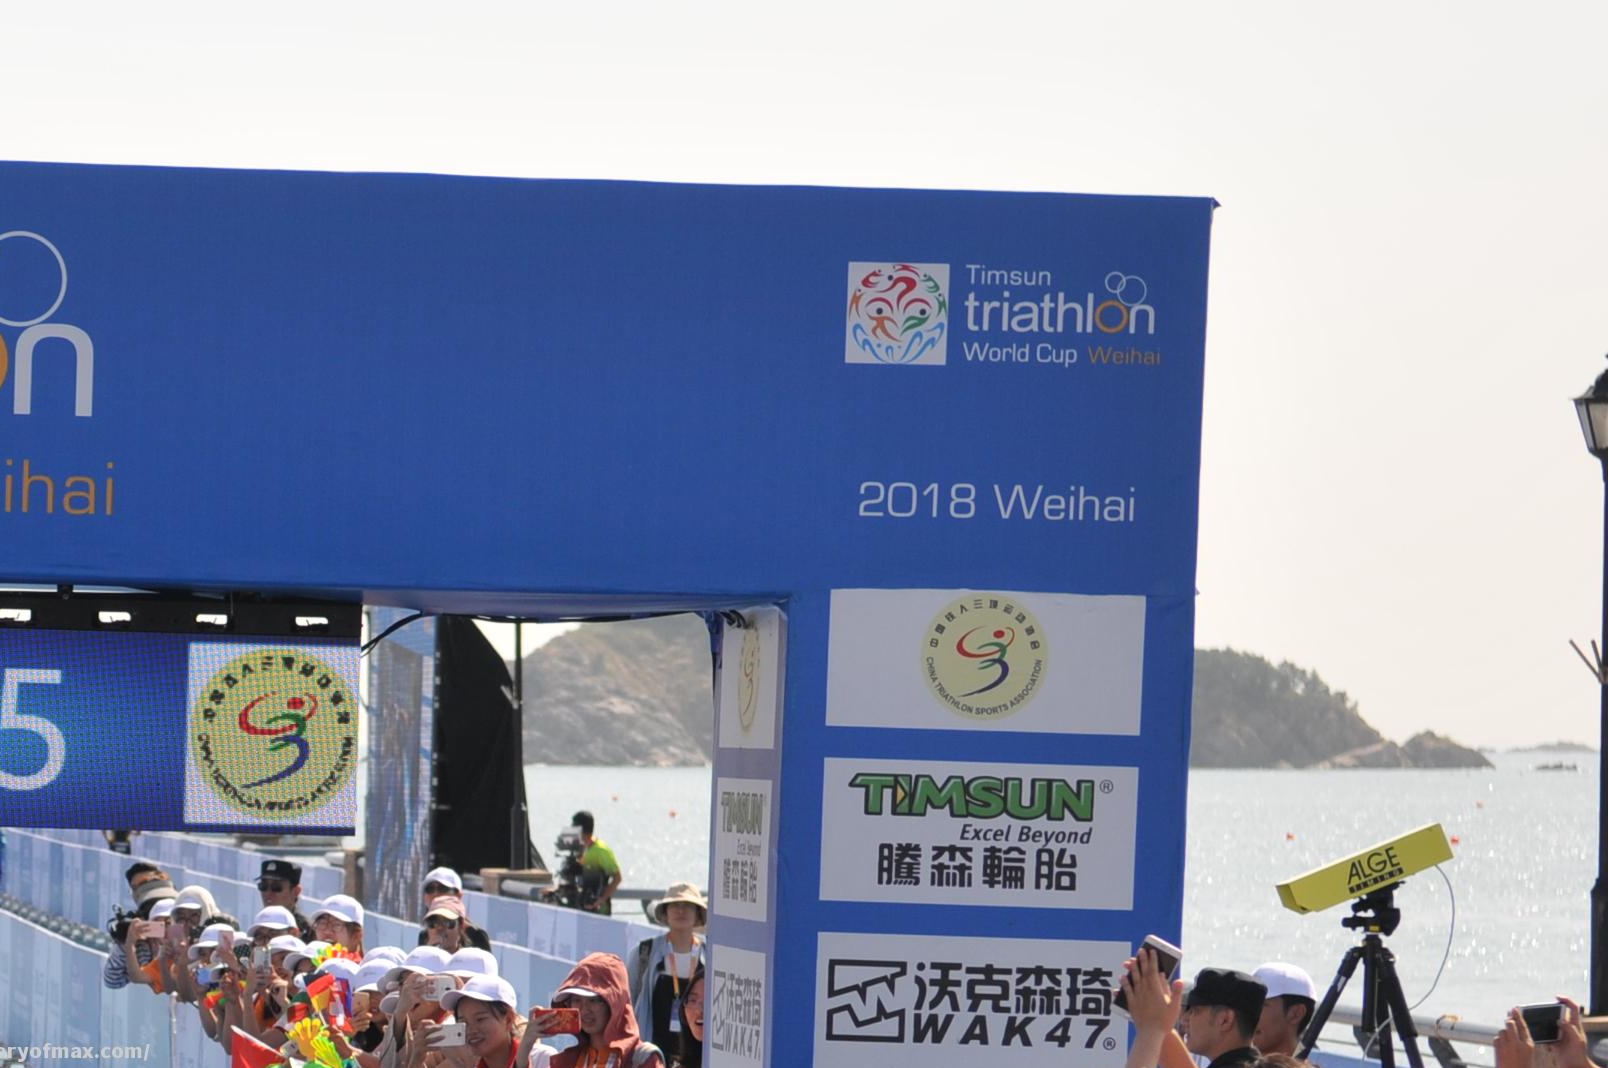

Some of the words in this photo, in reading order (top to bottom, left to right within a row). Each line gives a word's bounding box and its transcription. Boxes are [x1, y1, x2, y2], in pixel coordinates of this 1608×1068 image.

[966, 265, 1051, 286] Timsun
[964, 291, 1155, 334] triathlon
[963, 342, 1029, 363] World
[1036, 344, 1078, 368] Cup
[1087, 346, 1160, 365] Weihai
[859, 481, 976, 518] 2018
[994, 484, 1135, 522] Weihai
[975, 703, 1009, 715] SPORTS
[1009, 659, 1042, 708] ASSOCIATION
[848, 773, 1094, 822] TIMSUN
[960, 824, 1011, 843] Excel
[1018, 827, 1092, 848] Beyond
[877, 842, 1077, 891] 騰森輪胎
[1348, 846, 1400, 885] ALGE
[913, 1013, 1111, 1049] WAK47
